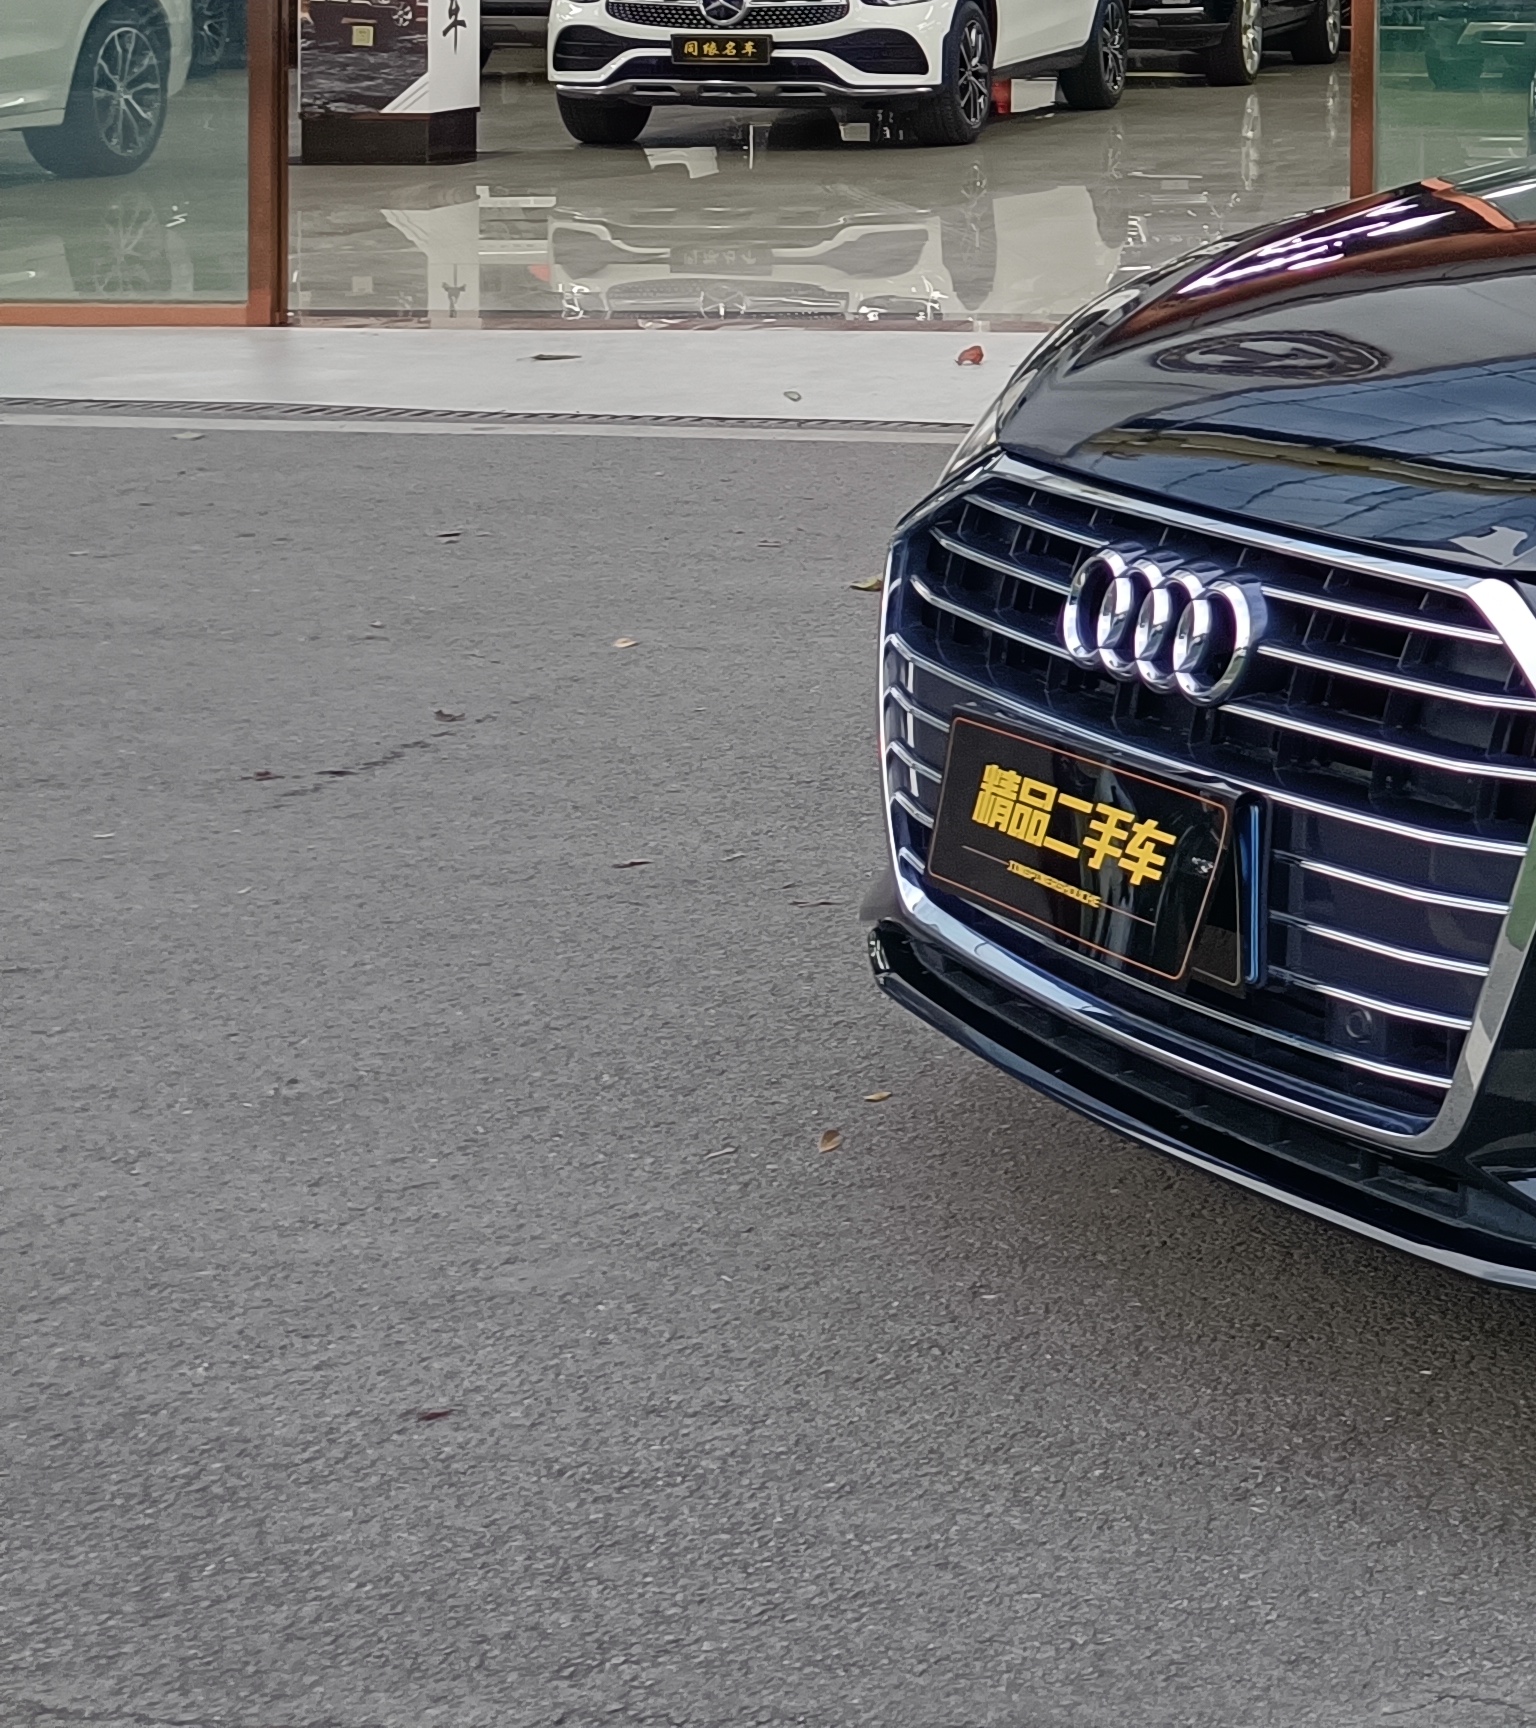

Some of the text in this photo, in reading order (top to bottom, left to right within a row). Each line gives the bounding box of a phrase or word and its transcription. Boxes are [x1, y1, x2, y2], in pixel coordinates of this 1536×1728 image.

[971, 764, 1178, 886] 精品二手车
